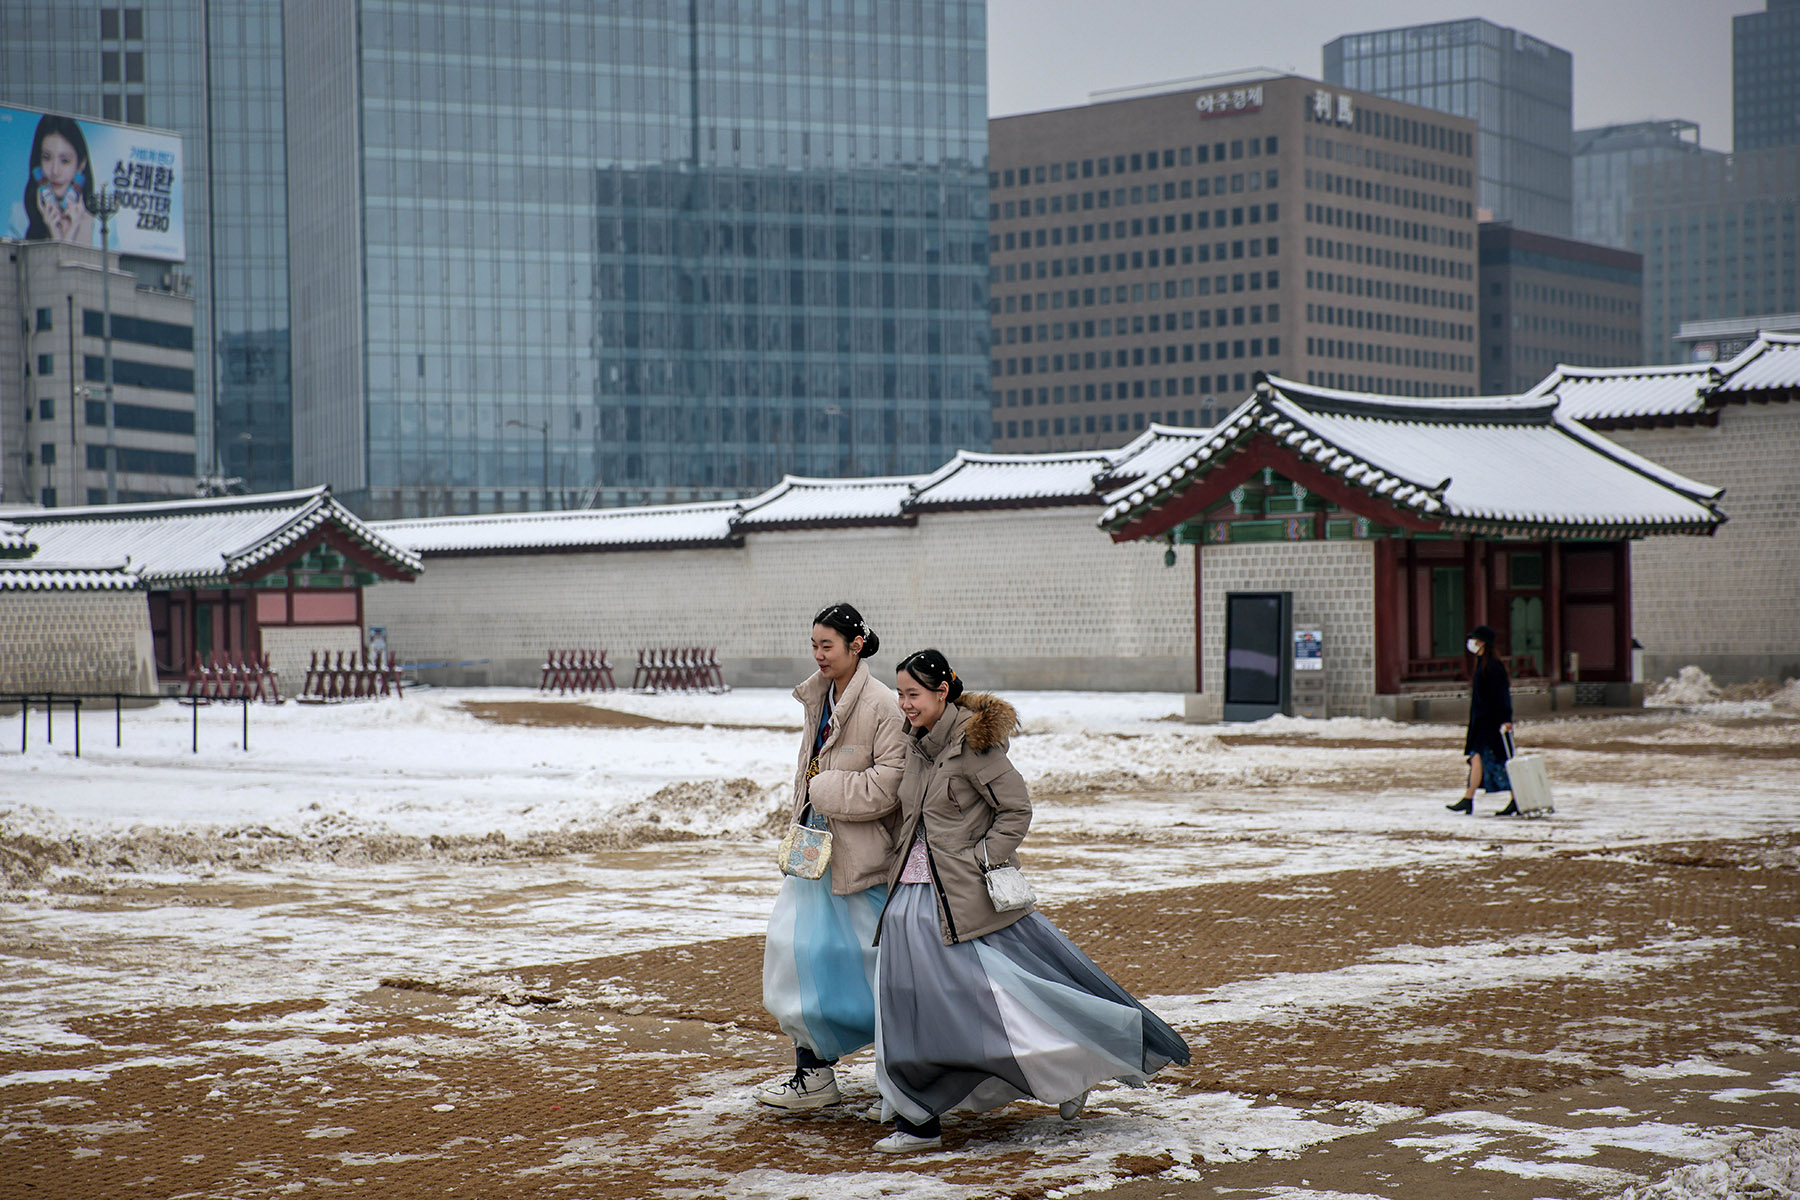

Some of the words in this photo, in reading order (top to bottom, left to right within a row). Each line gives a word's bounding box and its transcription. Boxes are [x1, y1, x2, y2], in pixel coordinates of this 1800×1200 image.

[1196, 85, 1263, 113] 아주경제
[114, 160, 174, 194] 상쾌환
[136, 211, 169, 233] ZERO
